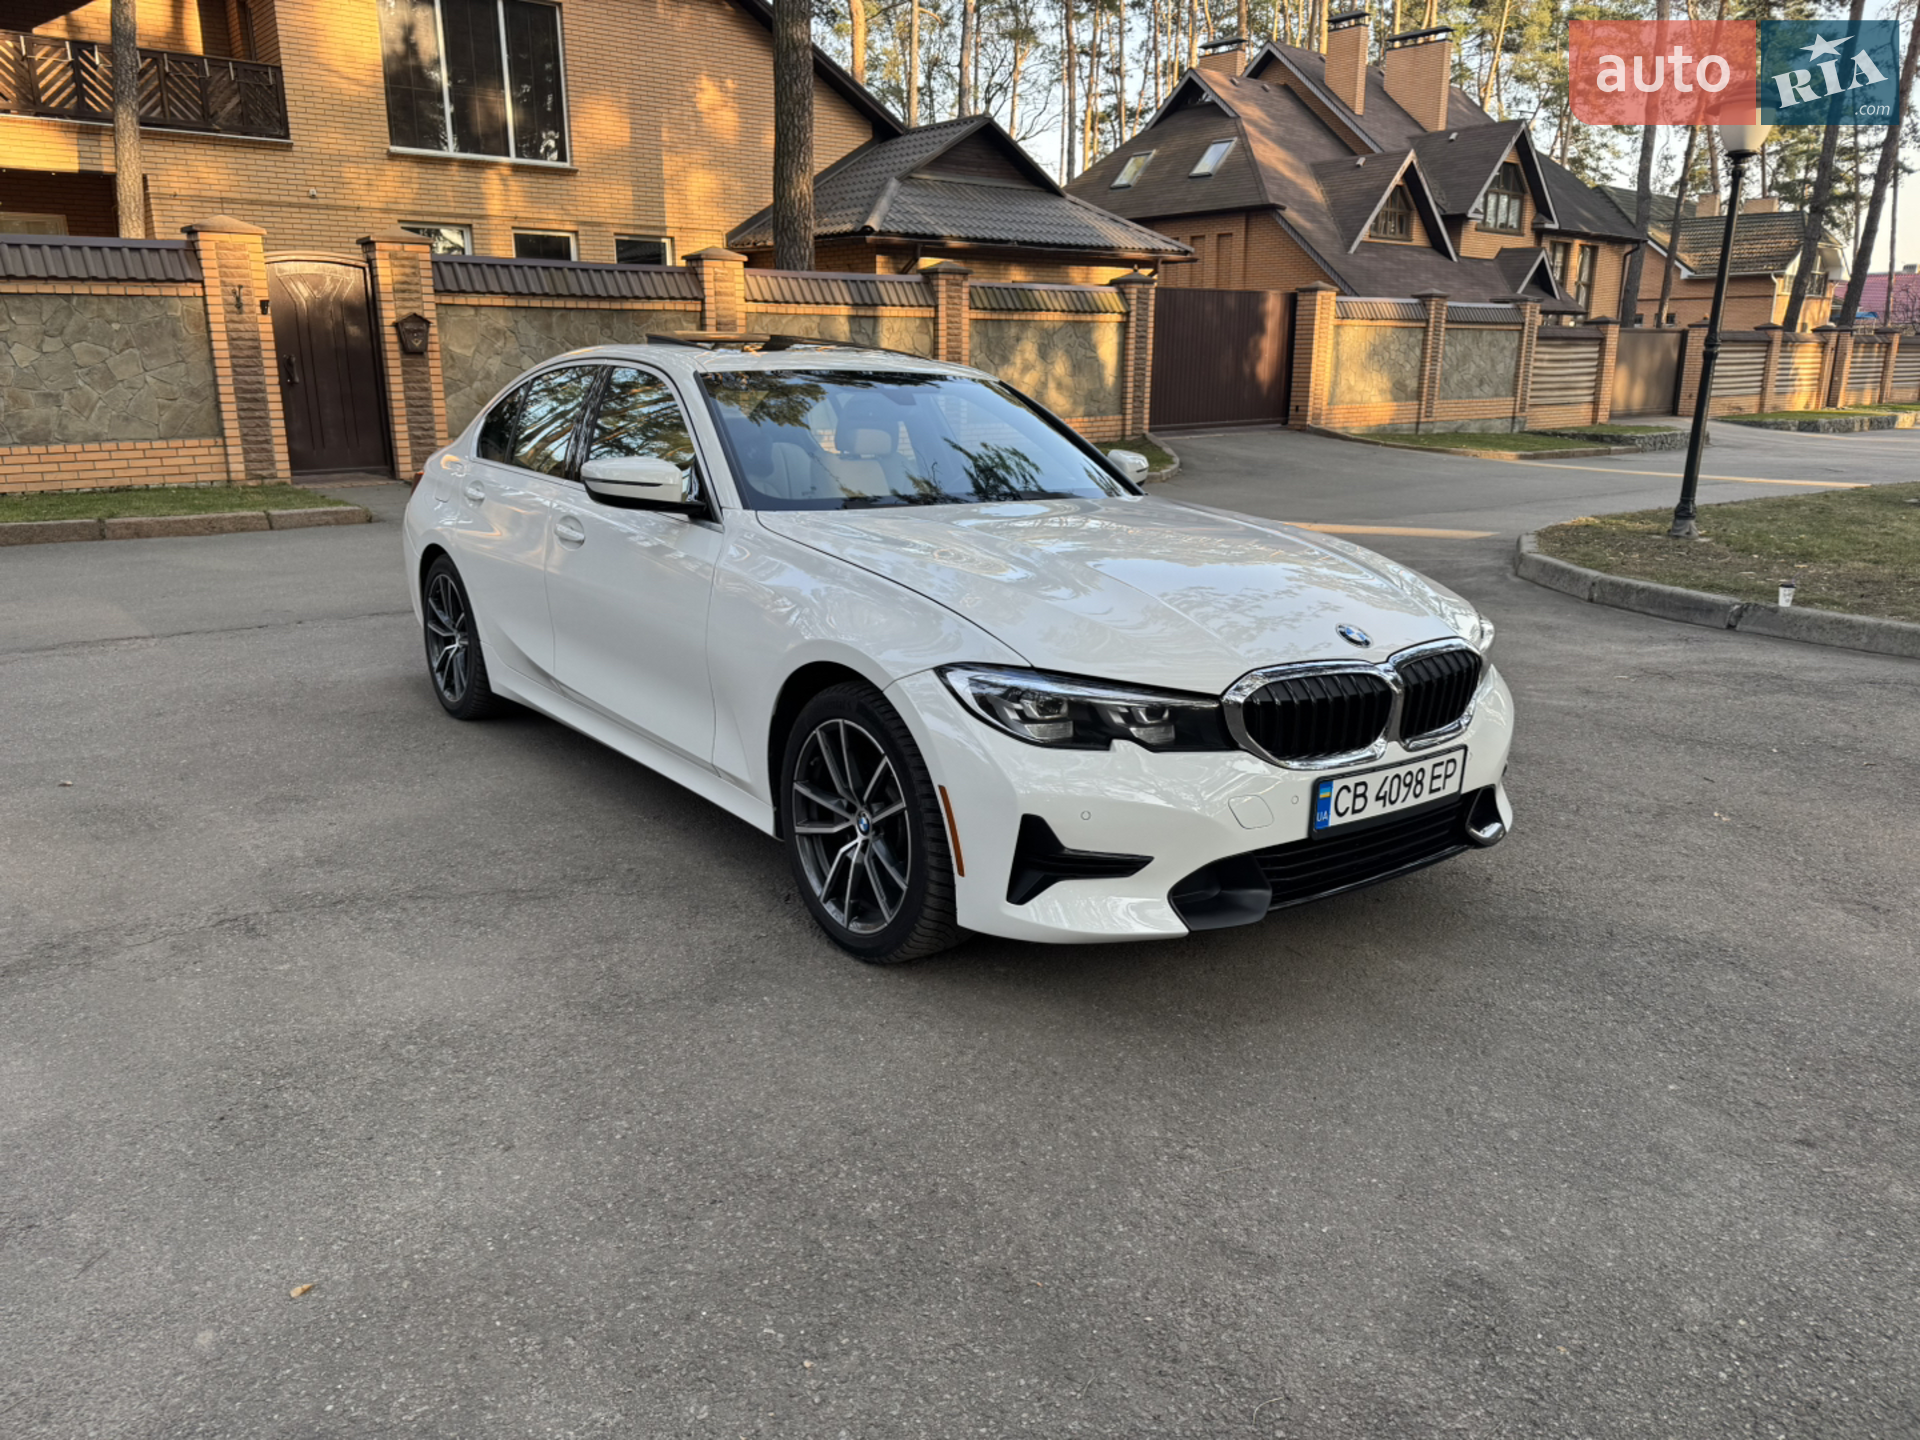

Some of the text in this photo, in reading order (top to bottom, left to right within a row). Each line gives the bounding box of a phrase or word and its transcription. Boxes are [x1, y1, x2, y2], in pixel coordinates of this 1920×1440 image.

[1334, 758, 1457, 818] CB 4098 EP
[1316, 810, 1329, 822] UA
